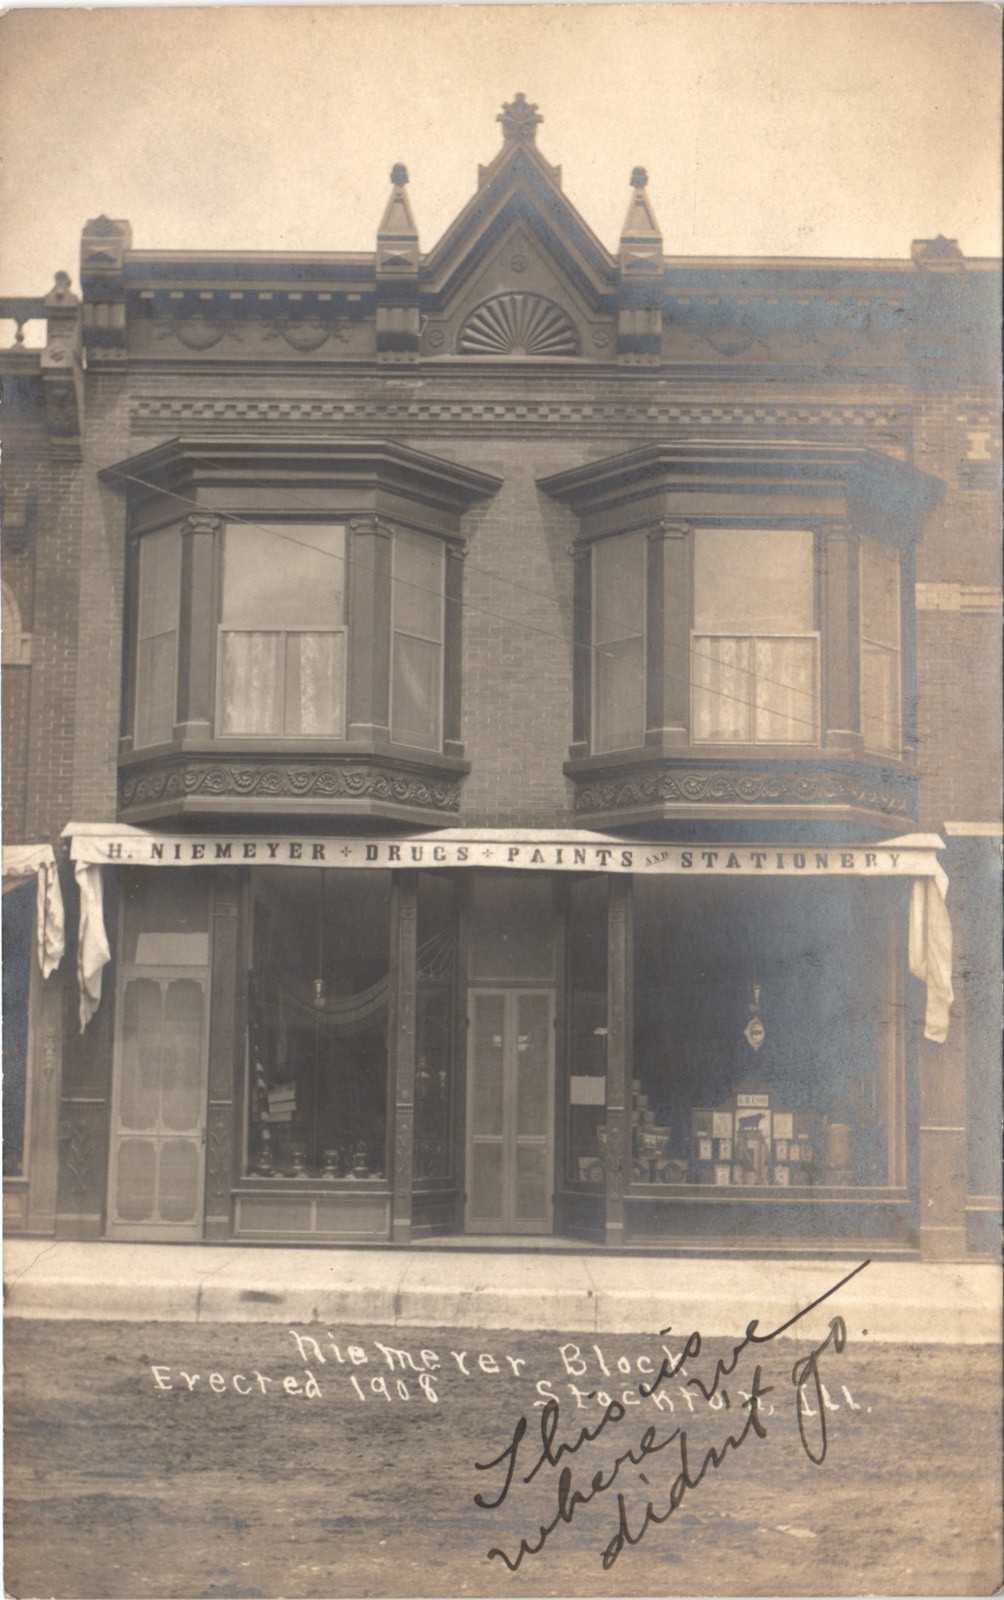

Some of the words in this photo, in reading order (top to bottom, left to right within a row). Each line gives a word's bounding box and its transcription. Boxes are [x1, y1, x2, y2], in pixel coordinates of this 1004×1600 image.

[108, 842, 133, 859] H.
[151, 843, 327, 861] NIEMEYER
[365, 844, 469, 862] DRUGS
[508, 847, 633, 868] PAINTS
[682, 851, 900, 869] STATIONERY
[474, 1399, 626, 1509] This
[639, 1326, 702, 1397] is
[487, 1426, 681, 1571] where
[687, 1259, 872, 1400] we
